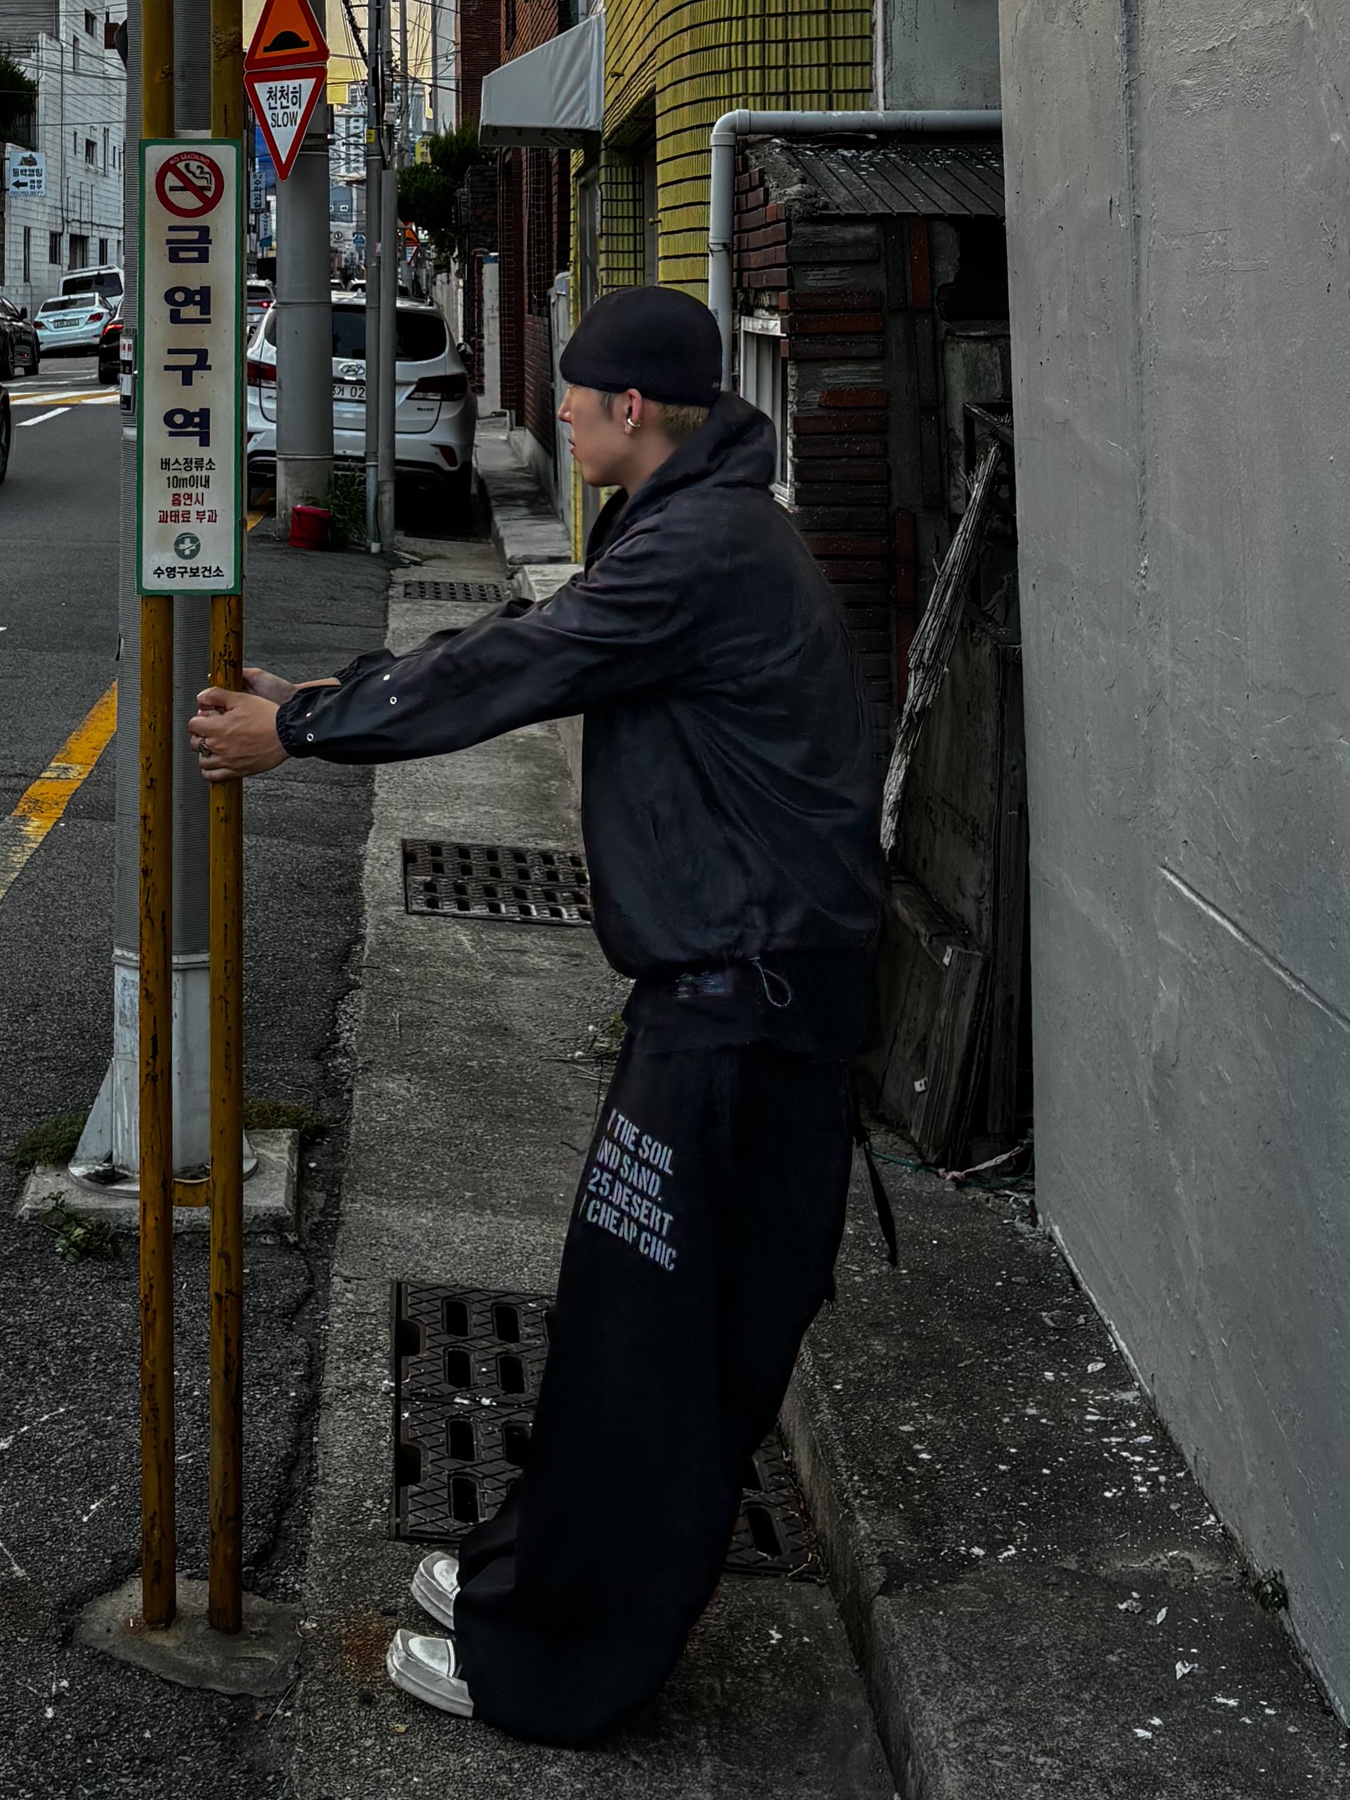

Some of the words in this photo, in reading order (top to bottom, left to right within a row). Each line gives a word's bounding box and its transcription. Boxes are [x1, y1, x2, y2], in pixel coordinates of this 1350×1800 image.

[266, 83, 302, 110] 천천히
[271, 111, 298, 128] SLOW
[350, 386, 365, 398] 02
[160, 457, 216, 472] 버스정류소
[166, 475, 210, 489] 10m이내
[171, 492, 204, 506] 흡연시
[158, 510, 192, 524] 과태료
[196, 509, 218, 524] 부과
[153, 565, 225, 579] 수영구보건소
[613, 1113, 640, 1152] THE
[638, 1134, 674, 1176] SOIL
[586, 1199, 639, 1244] CHEAP
[638, 1231, 677, 1271] CHIC
